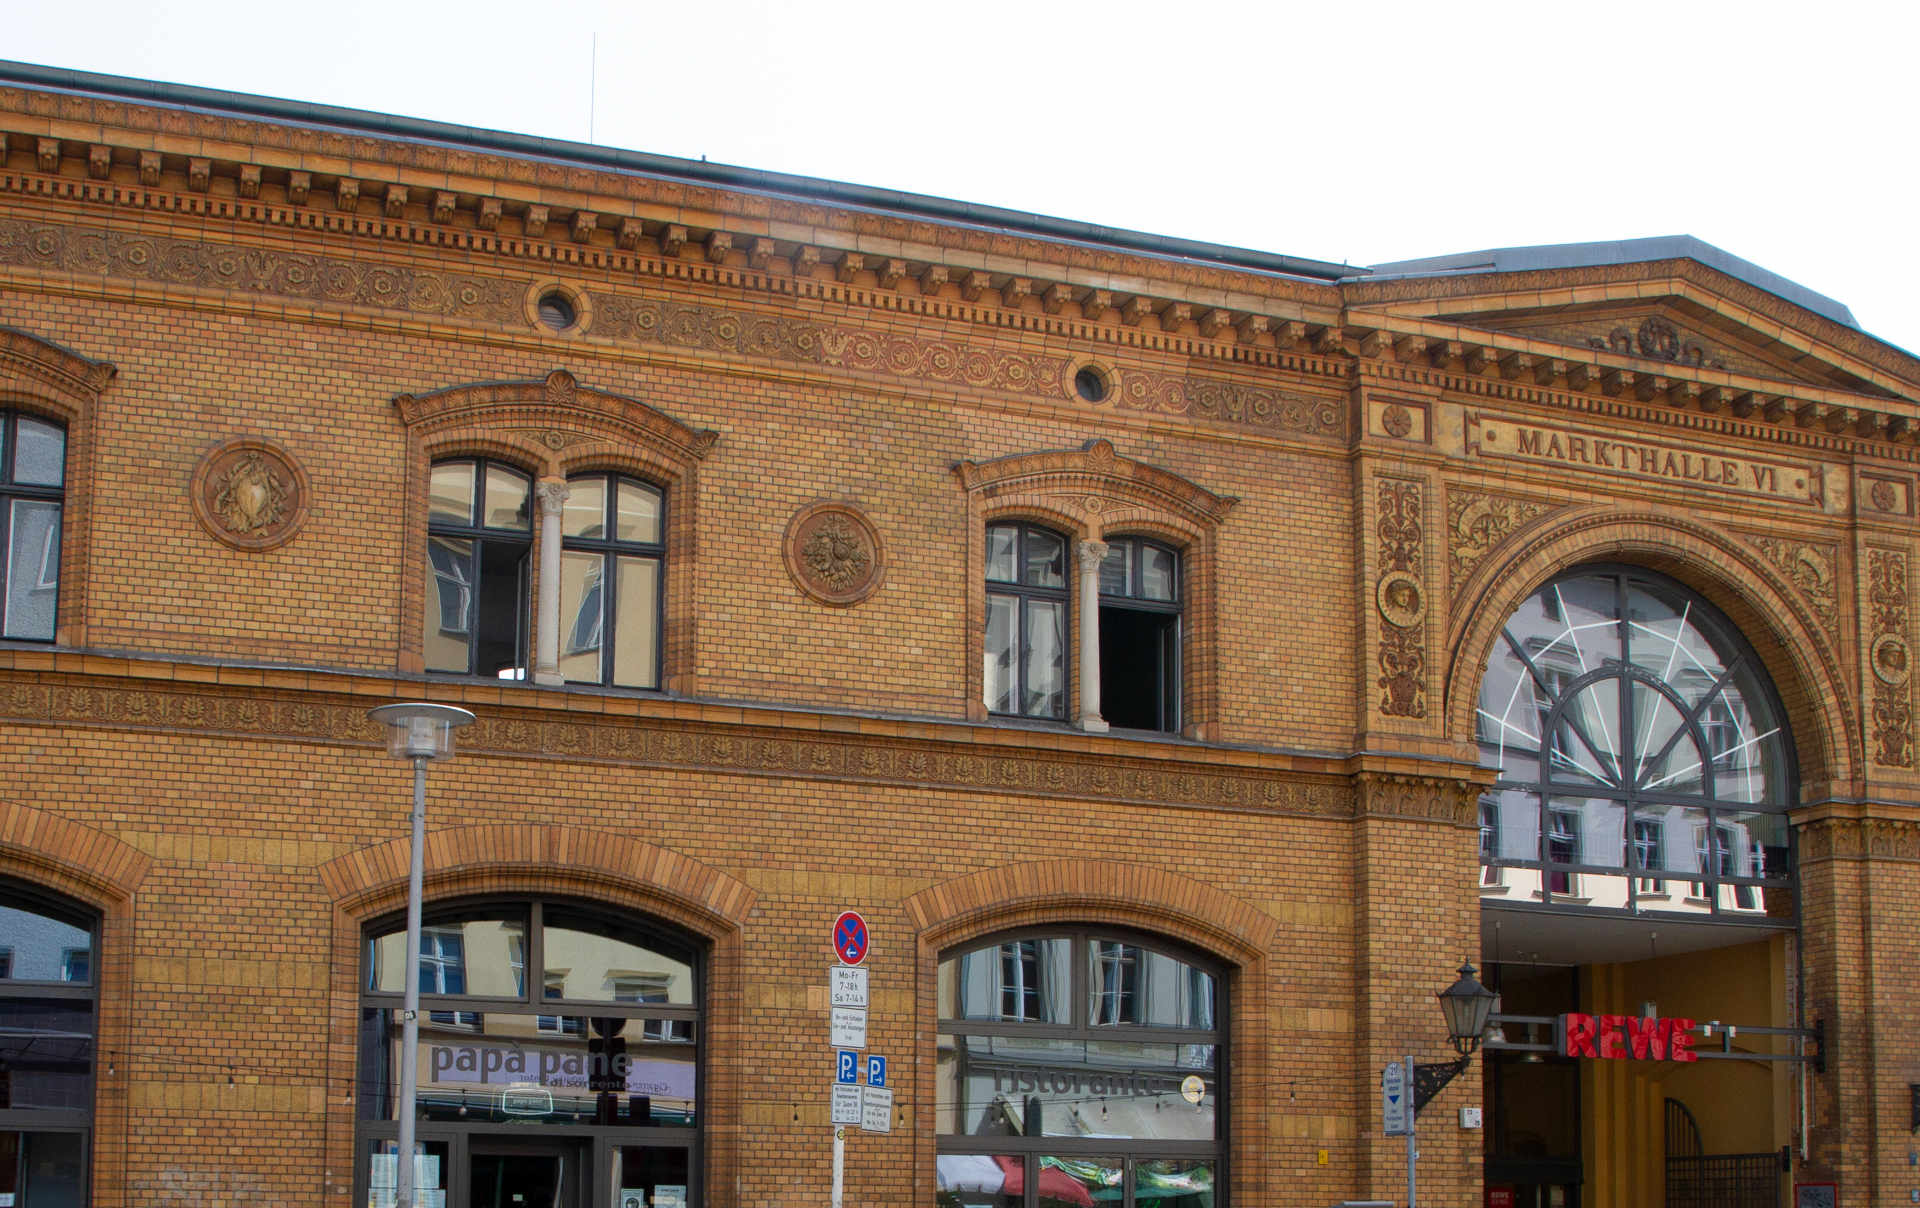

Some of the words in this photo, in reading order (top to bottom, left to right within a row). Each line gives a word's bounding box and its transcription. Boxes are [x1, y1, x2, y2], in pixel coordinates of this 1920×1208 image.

[1517, 428, 1739, 485] MARKTHALLE
[1749, 463, 1778, 492] VI
[1566, 1012, 1697, 1062] REWE
[431, 1040, 526, 1084] papà
[539, 1047, 633, 1085] pane
[993, 1070, 1161, 1096] ristorante
